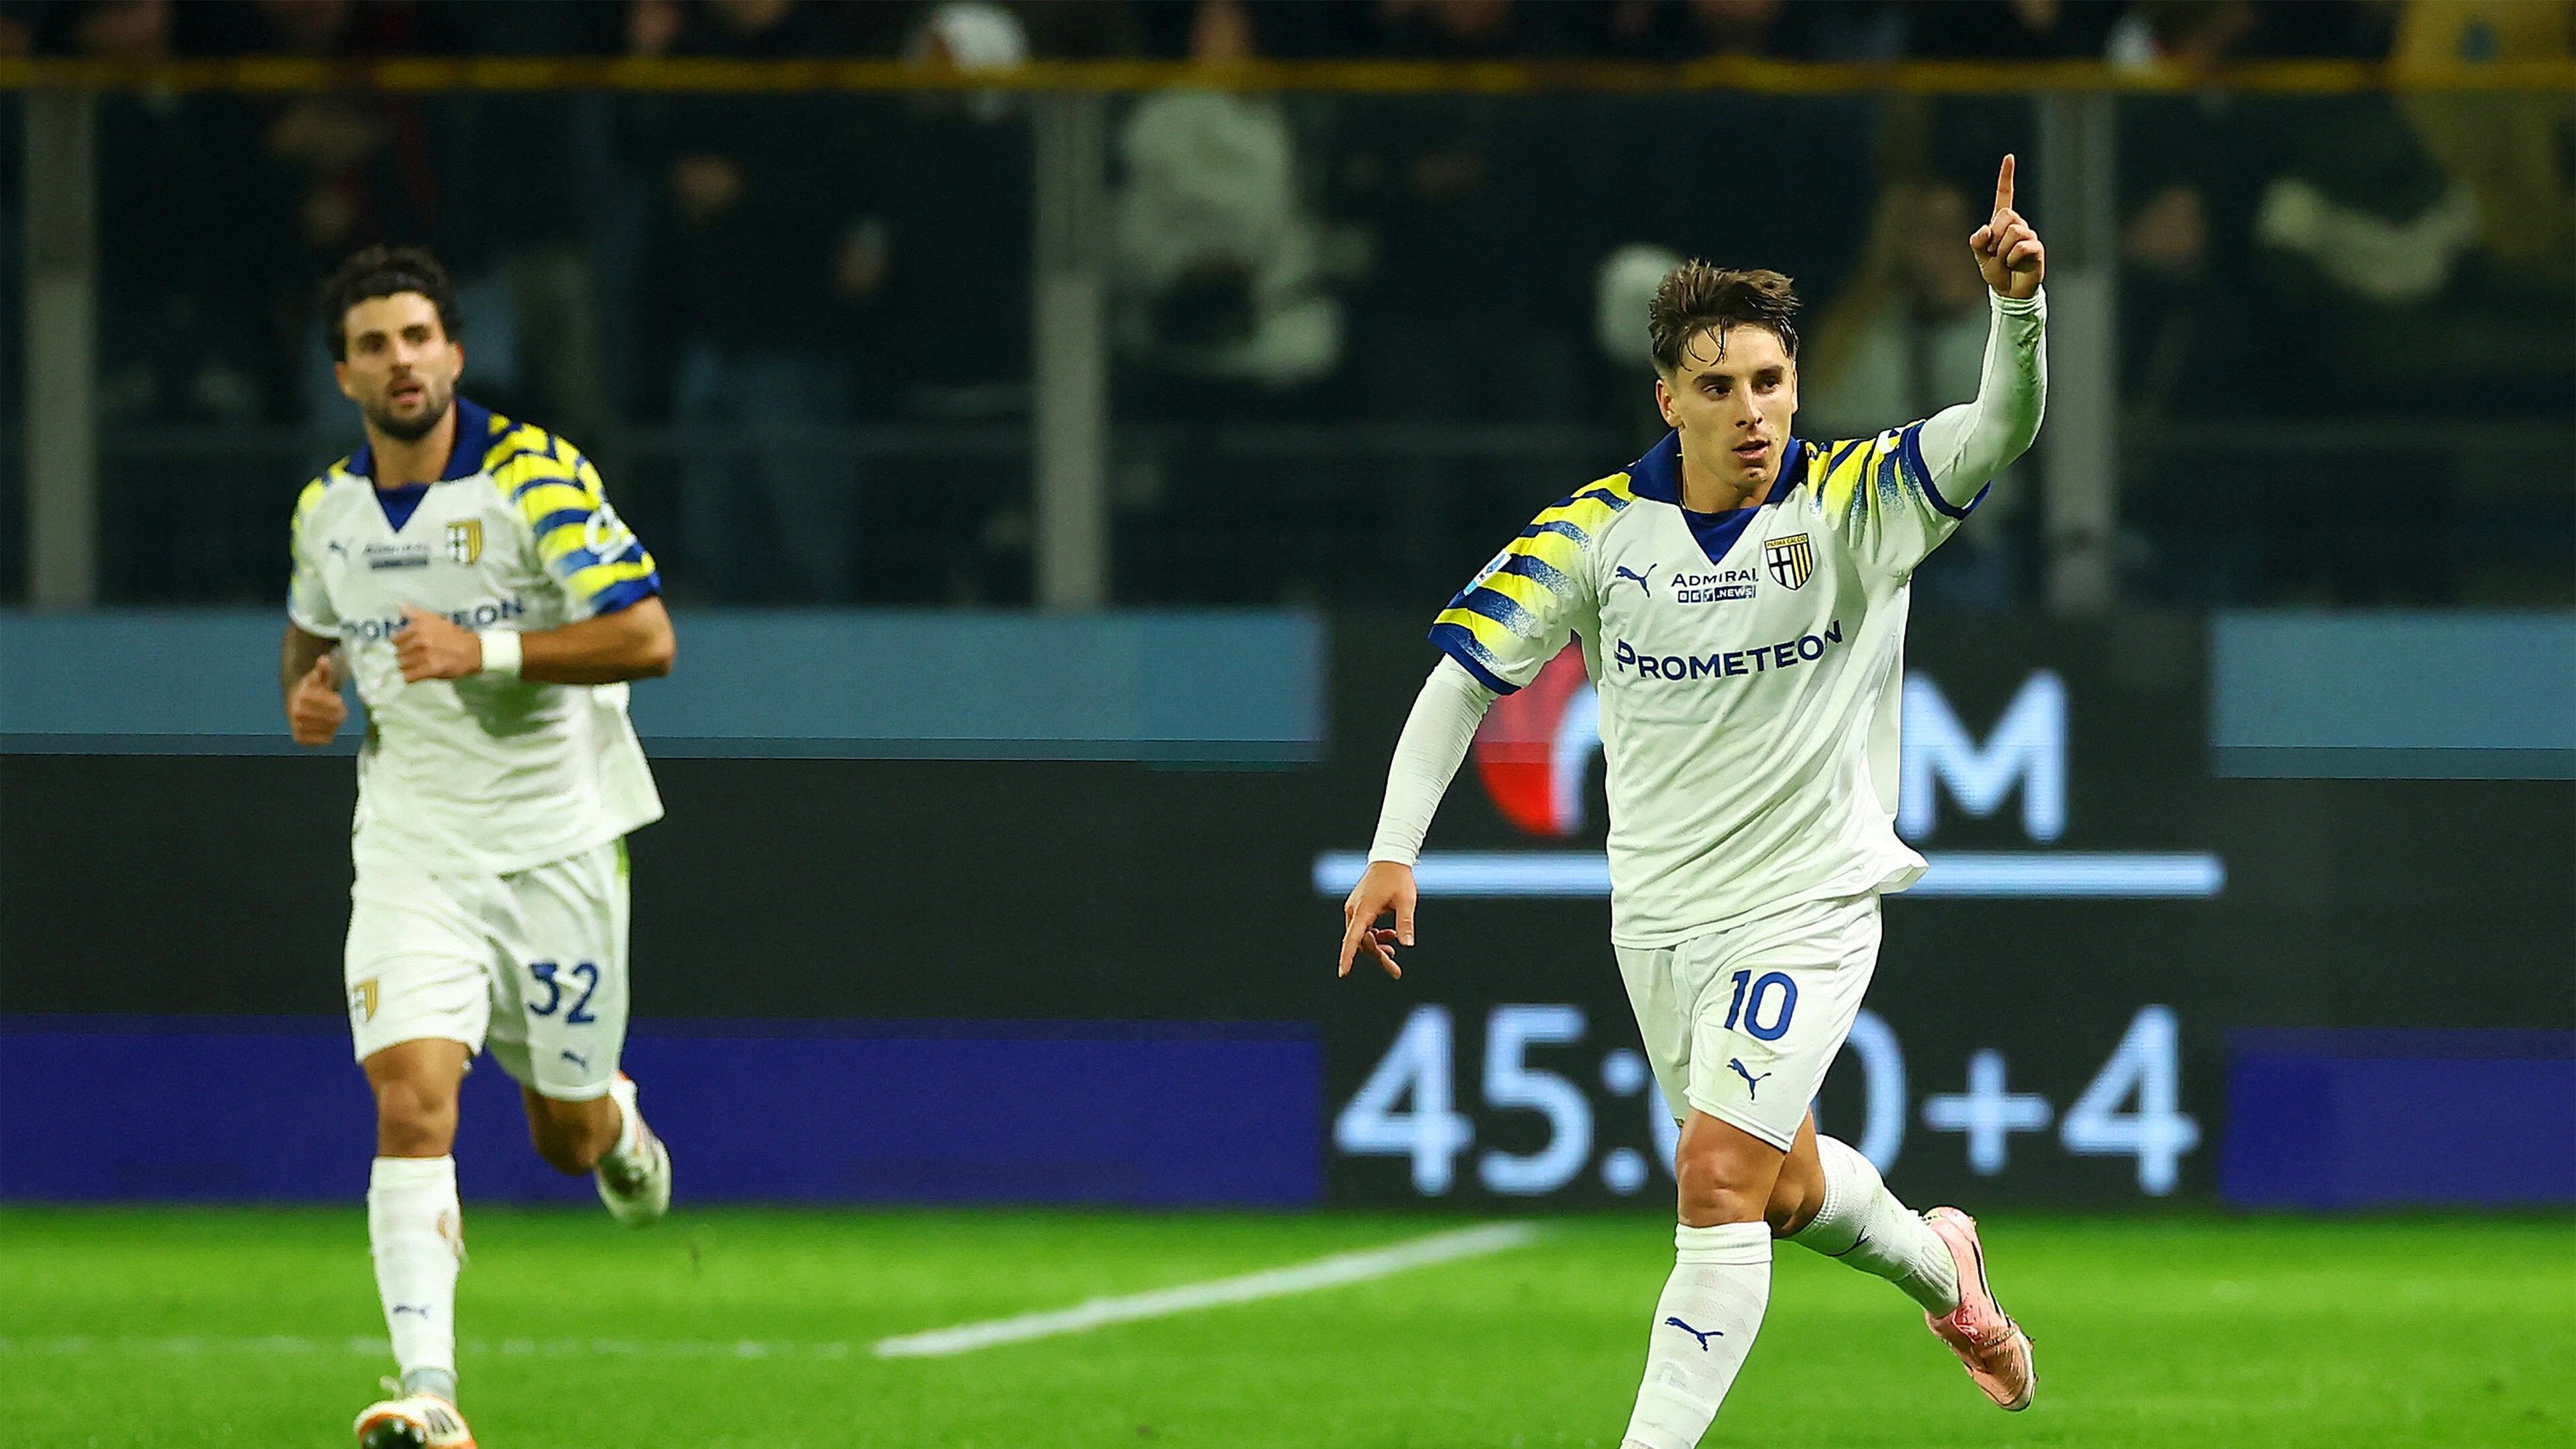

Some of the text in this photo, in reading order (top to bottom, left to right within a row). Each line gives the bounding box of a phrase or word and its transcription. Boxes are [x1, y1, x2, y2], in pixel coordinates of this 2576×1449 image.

[1671, 568, 1759, 588] ADMIRAL
[1614, 619, 1843, 681] PROMETEON
[529, 962, 598, 1023] 32
[1724, 970, 1798, 1041] 10
[1333, 1002, 2200, 1197] 45:0+4
